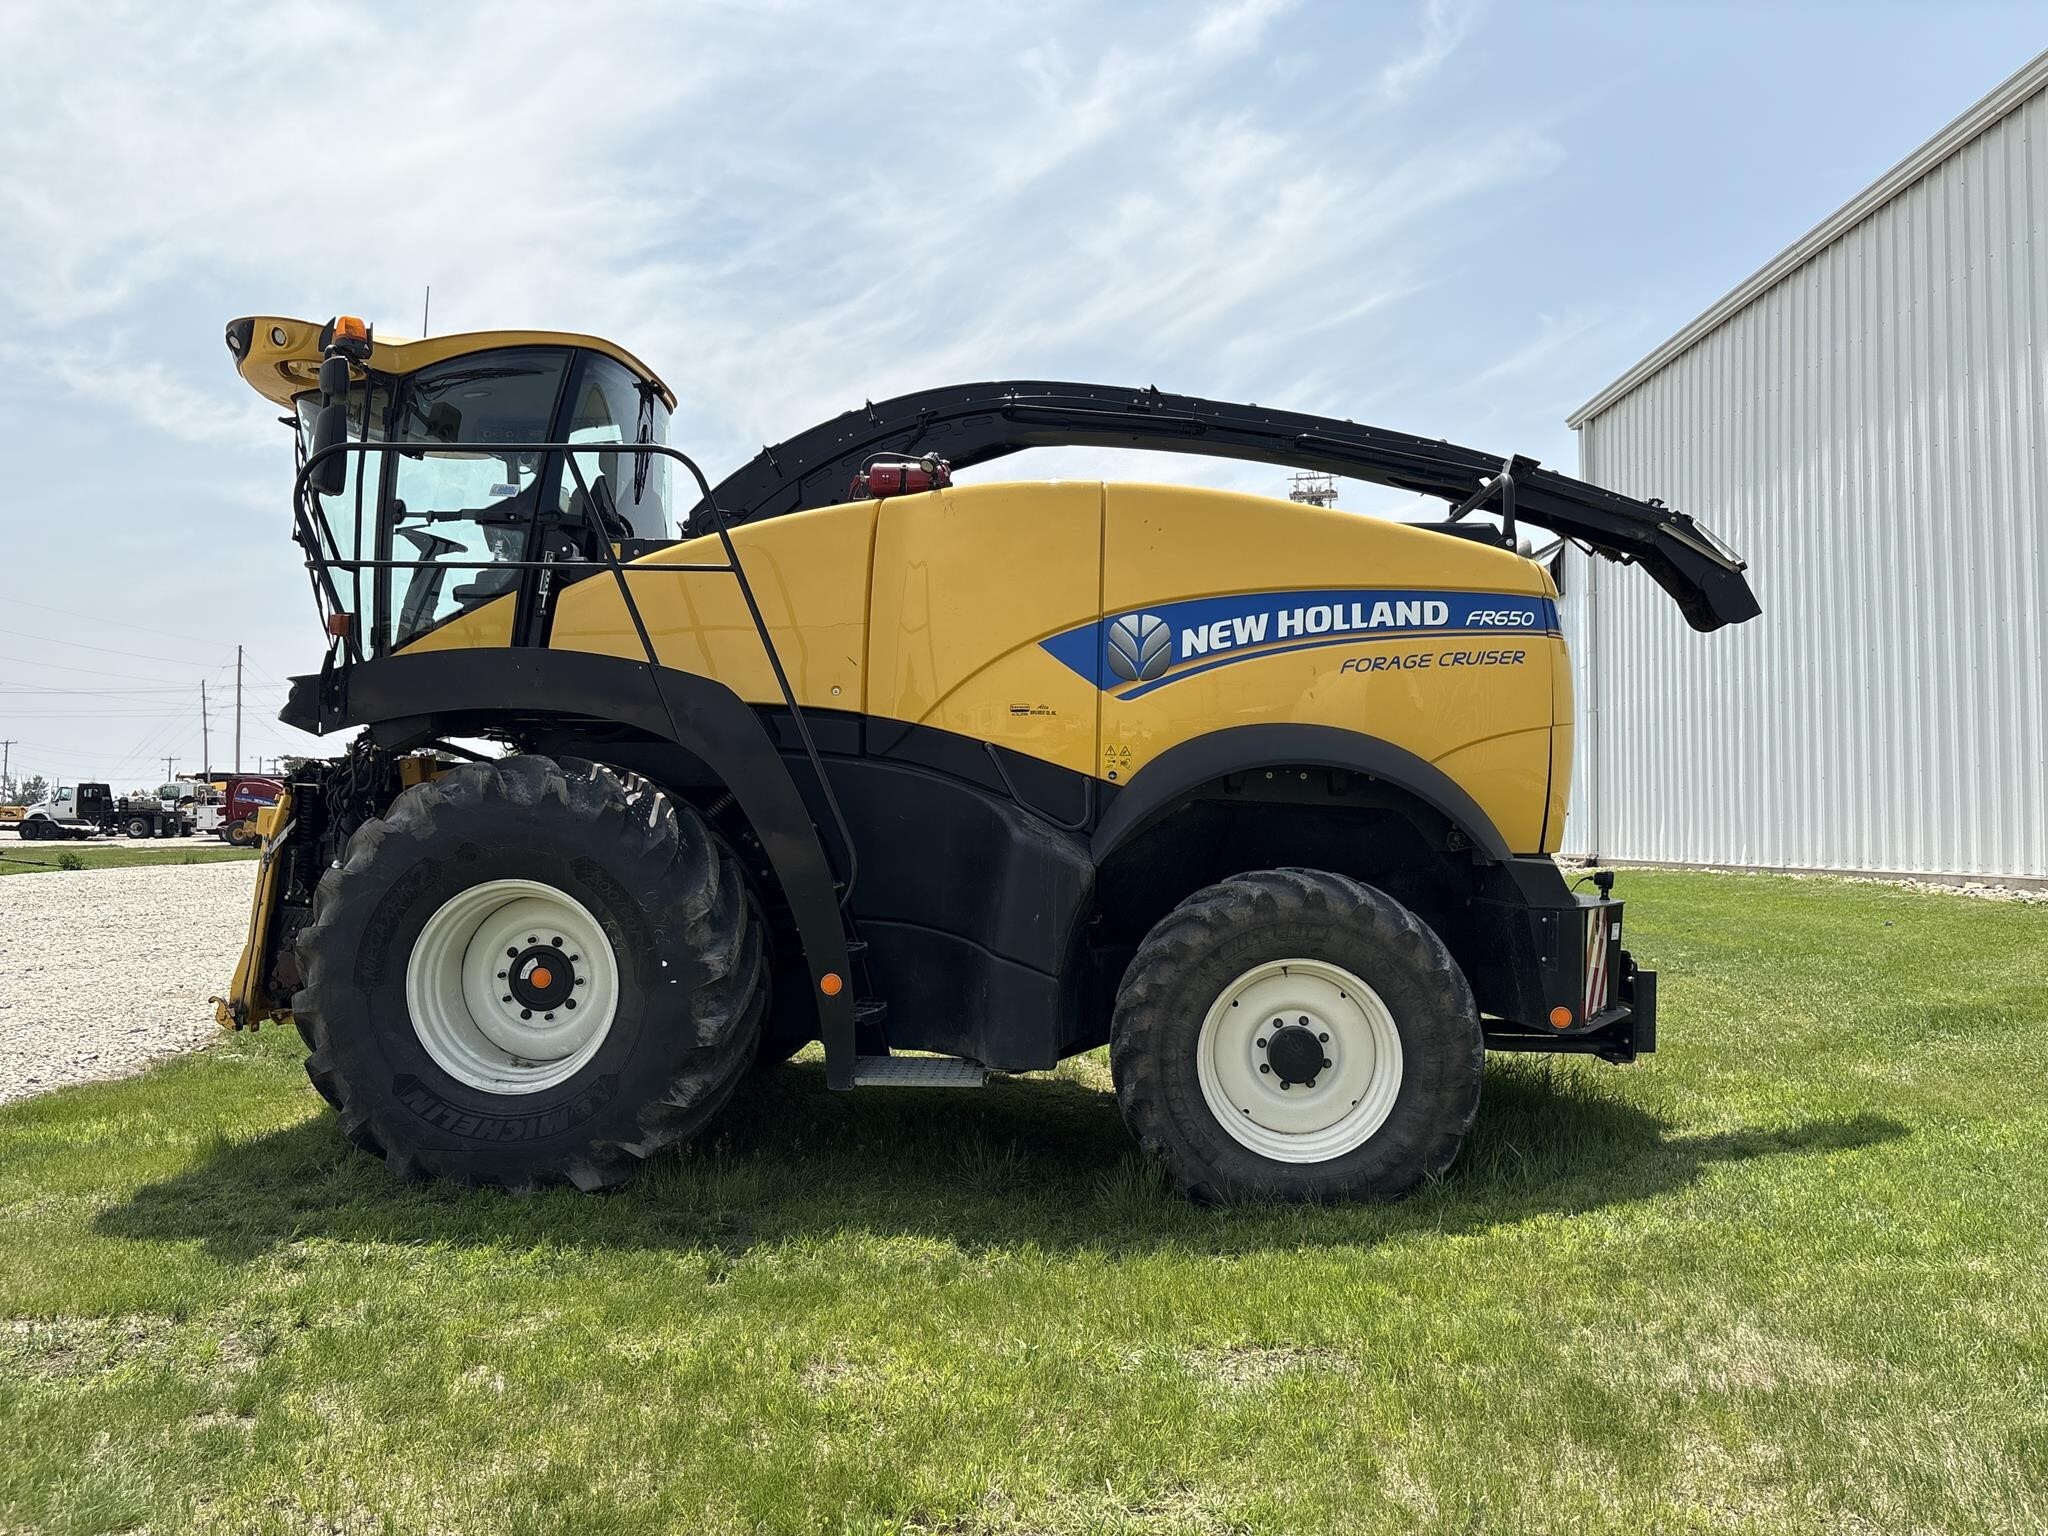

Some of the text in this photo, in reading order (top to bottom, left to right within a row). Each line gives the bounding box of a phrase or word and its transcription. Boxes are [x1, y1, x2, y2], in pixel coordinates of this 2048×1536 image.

[1181, 600, 1449, 658] NEW HOLLAND
[1465, 610, 1535, 627] FR650
[1340, 650, 1526, 674] FORAGE CRUISER
[401, 1089, 571, 1142] MICHELIN
